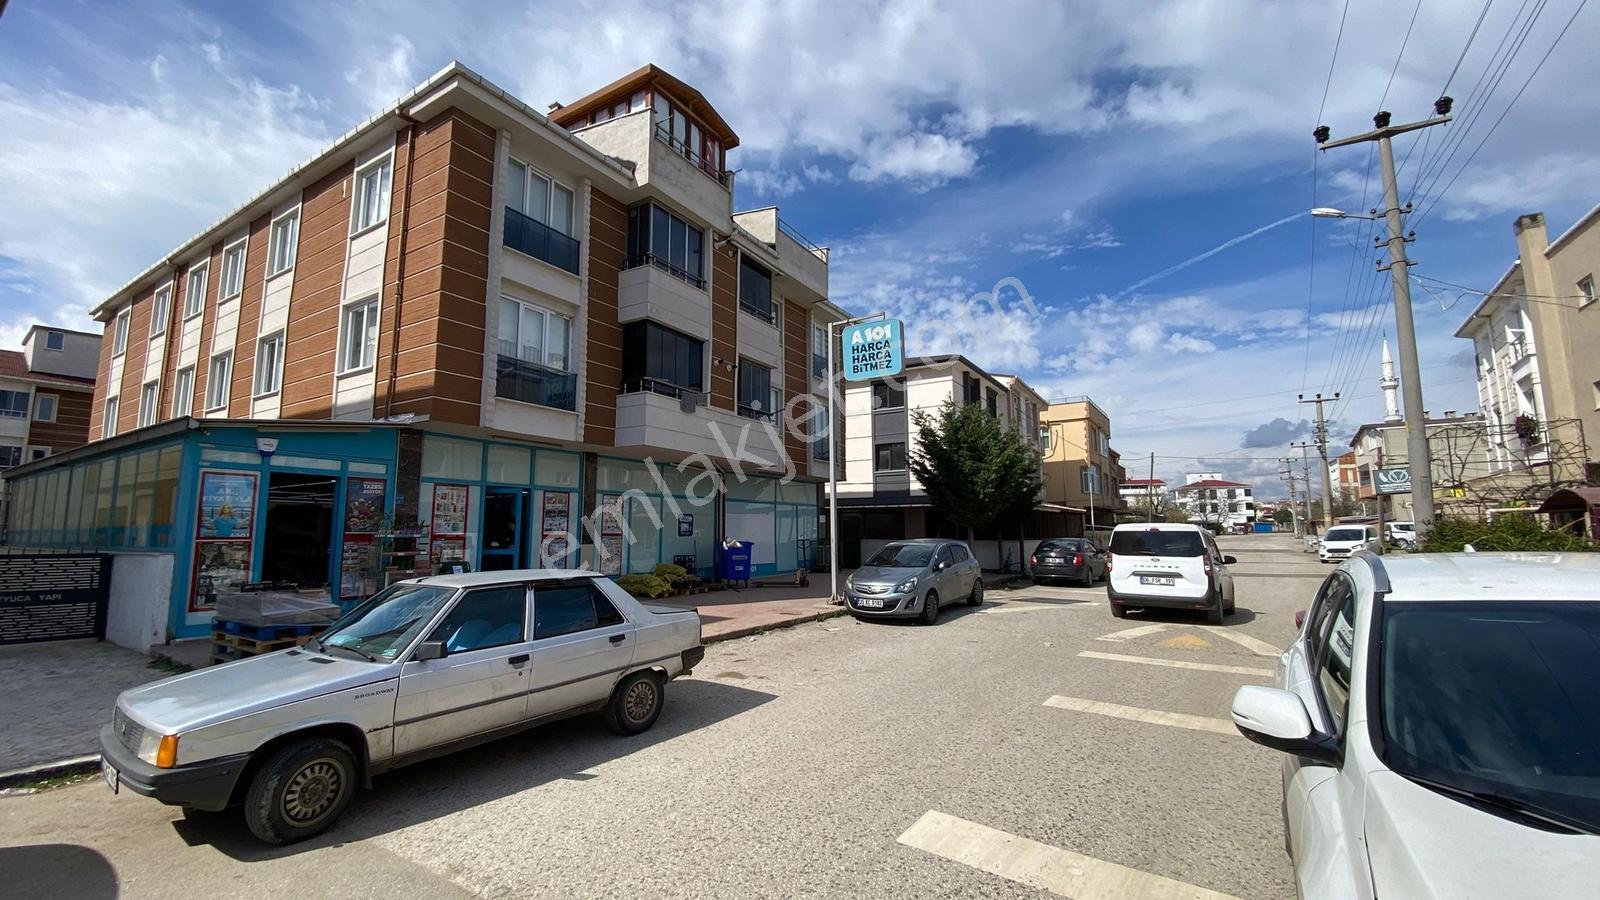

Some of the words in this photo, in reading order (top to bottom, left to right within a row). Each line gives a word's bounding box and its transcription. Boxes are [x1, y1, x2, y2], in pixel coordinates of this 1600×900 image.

[852, 340, 891, 354] HARCA
[852, 350, 892, 364] HARCA
[39, 592, 62, 601] YAPI
[354, 687, 395, 700] BROADWAY
